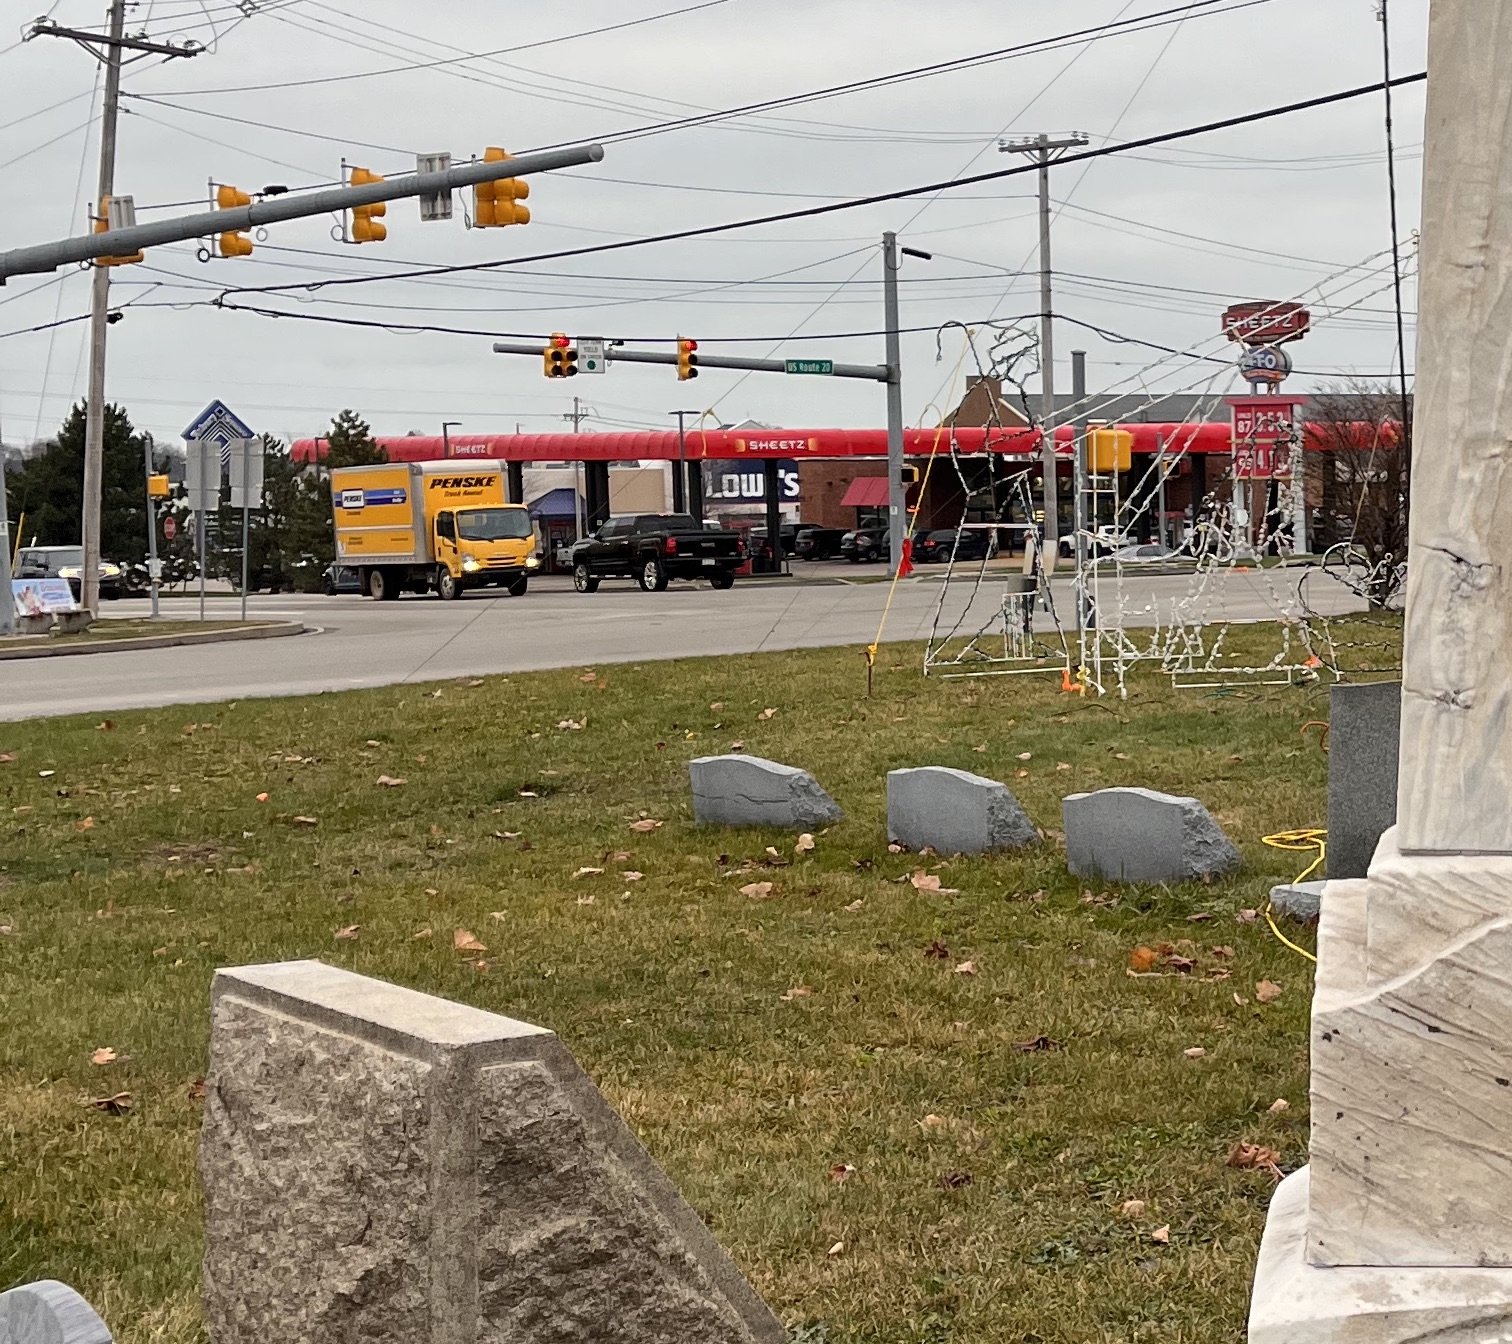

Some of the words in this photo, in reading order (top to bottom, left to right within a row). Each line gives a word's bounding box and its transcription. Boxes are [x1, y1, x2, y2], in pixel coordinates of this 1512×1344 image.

[1226, 314, 1293, 330] SHEETZ
[788, 361, 797, 372] US
[799, 362, 820, 373] Route
[822, 362, 831, 373] 20
[1237, 420, 1252, 433] 87
[749, 439, 806, 450] SHEETZ
[429, 476, 497, 489] PENSKE
[705, 468, 799, 499] LOW'S
[343, 495, 363, 503] PENSKE
